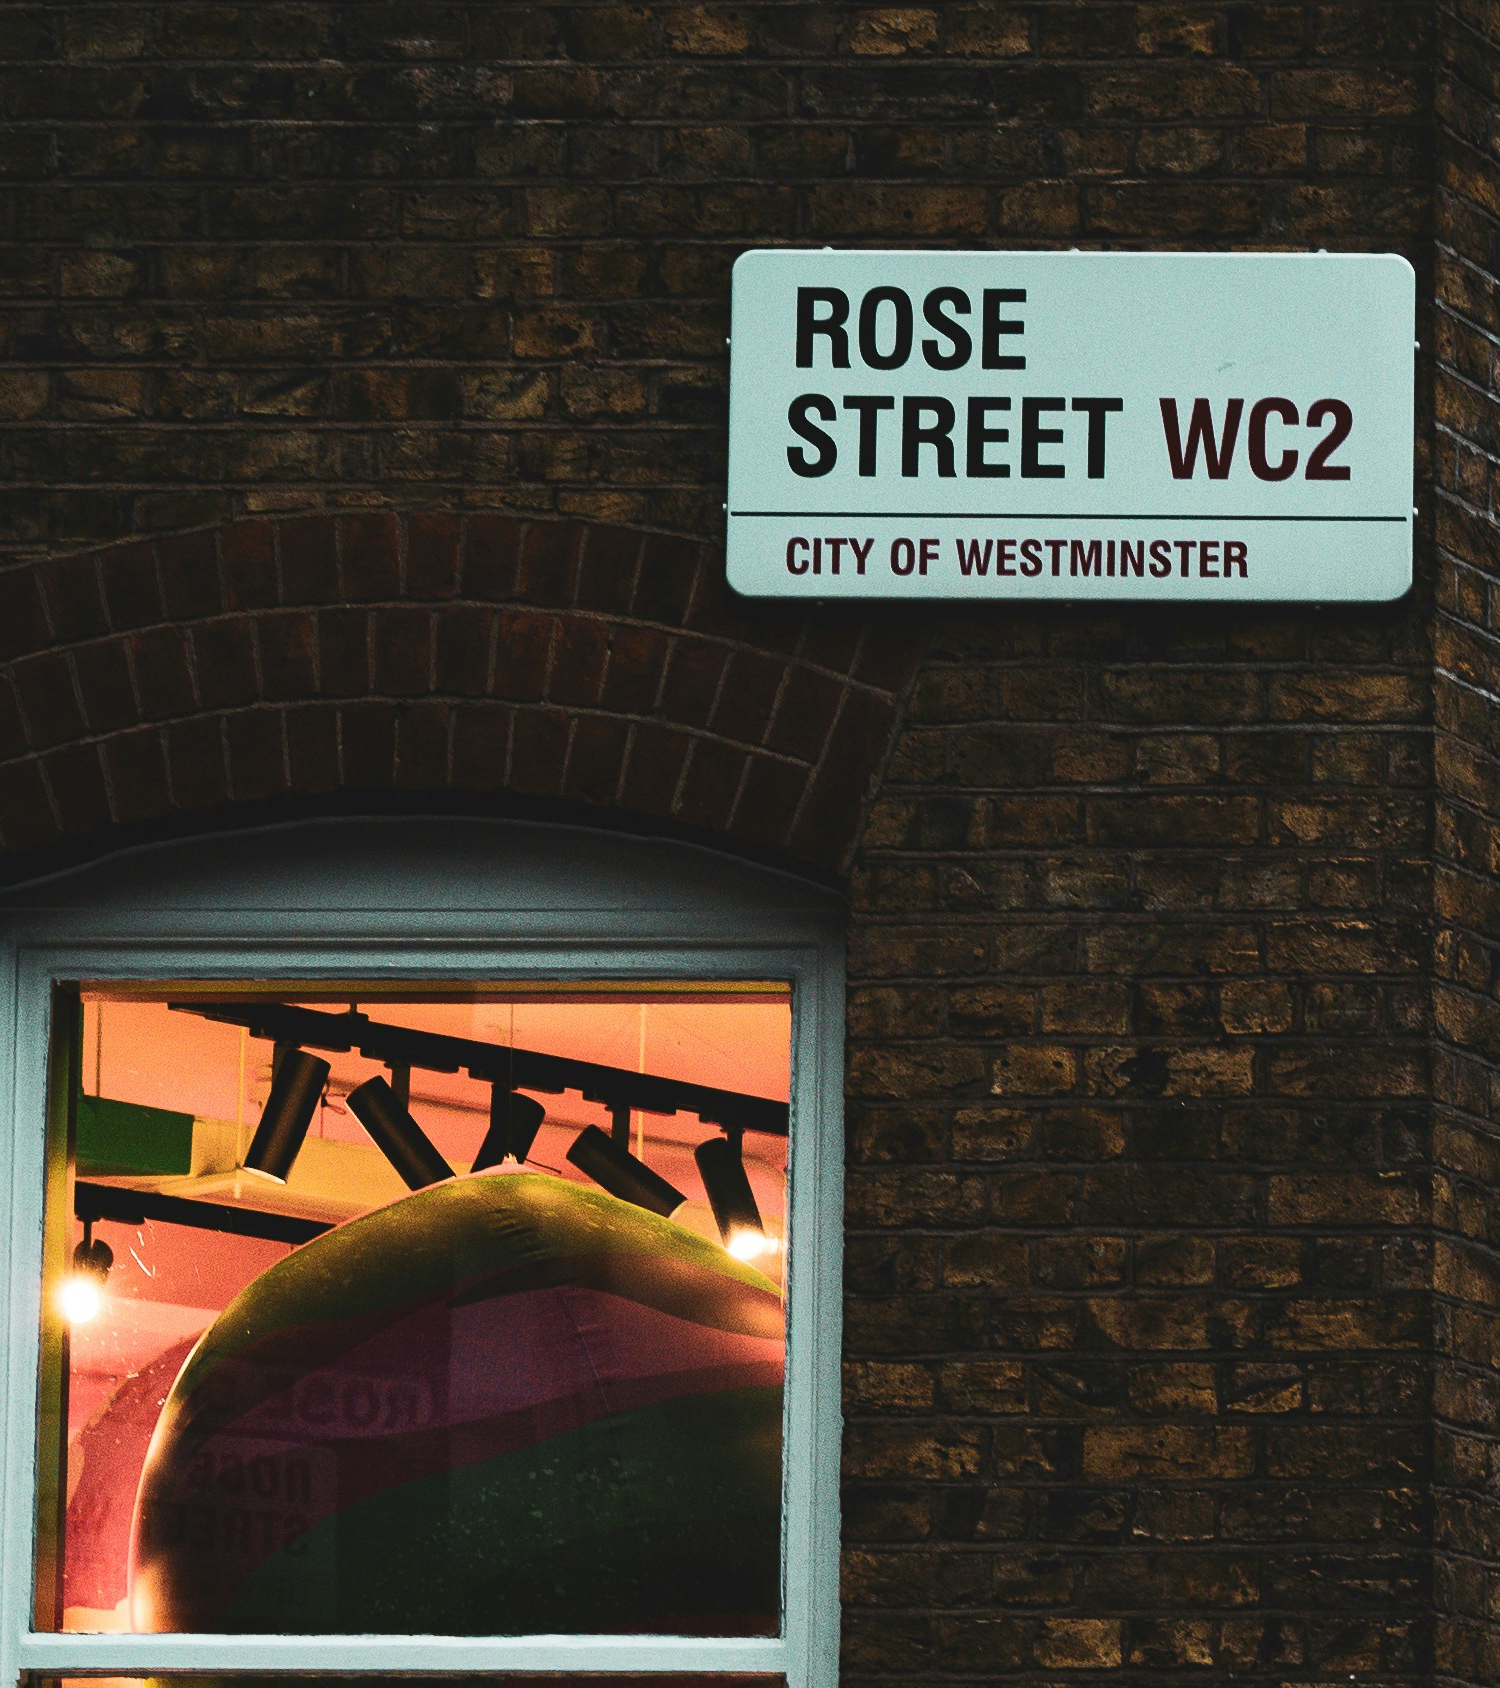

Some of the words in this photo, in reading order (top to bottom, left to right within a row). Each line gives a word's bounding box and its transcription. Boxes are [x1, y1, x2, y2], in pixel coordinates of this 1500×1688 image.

[795, 285, 1027, 371] ROSE
[786, 393, 1124, 479] STREET
[1158, 396, 1353, 482] WC2
[786, 536, 875, 576] CITY
[890, 537, 941, 576] OF
[955, 538, 1249, 579] WESTMINSTER
